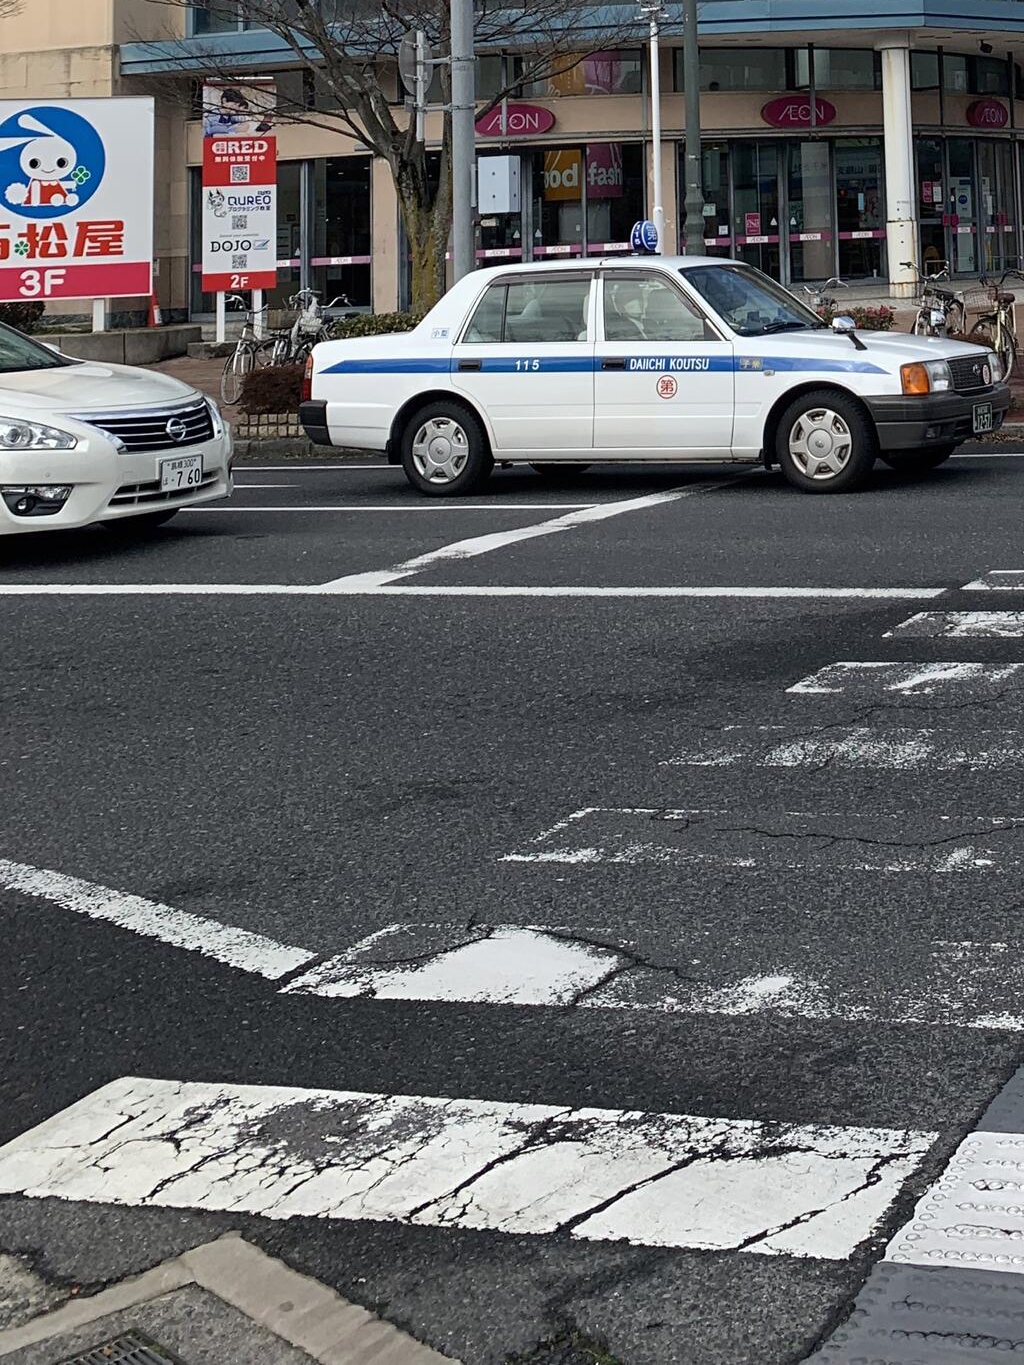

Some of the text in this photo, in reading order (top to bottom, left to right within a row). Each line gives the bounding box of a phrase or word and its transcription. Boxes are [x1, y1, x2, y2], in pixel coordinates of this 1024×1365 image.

[228, 195, 271, 206] QUREO
[210, 239, 251, 252] DOJO
[19, 268, 66, 296] 3F
[230, 274, 249, 288] 2F
[515, 359, 540, 371] 115
[630, 358, 710, 370] DAIICHI KOUTSU
